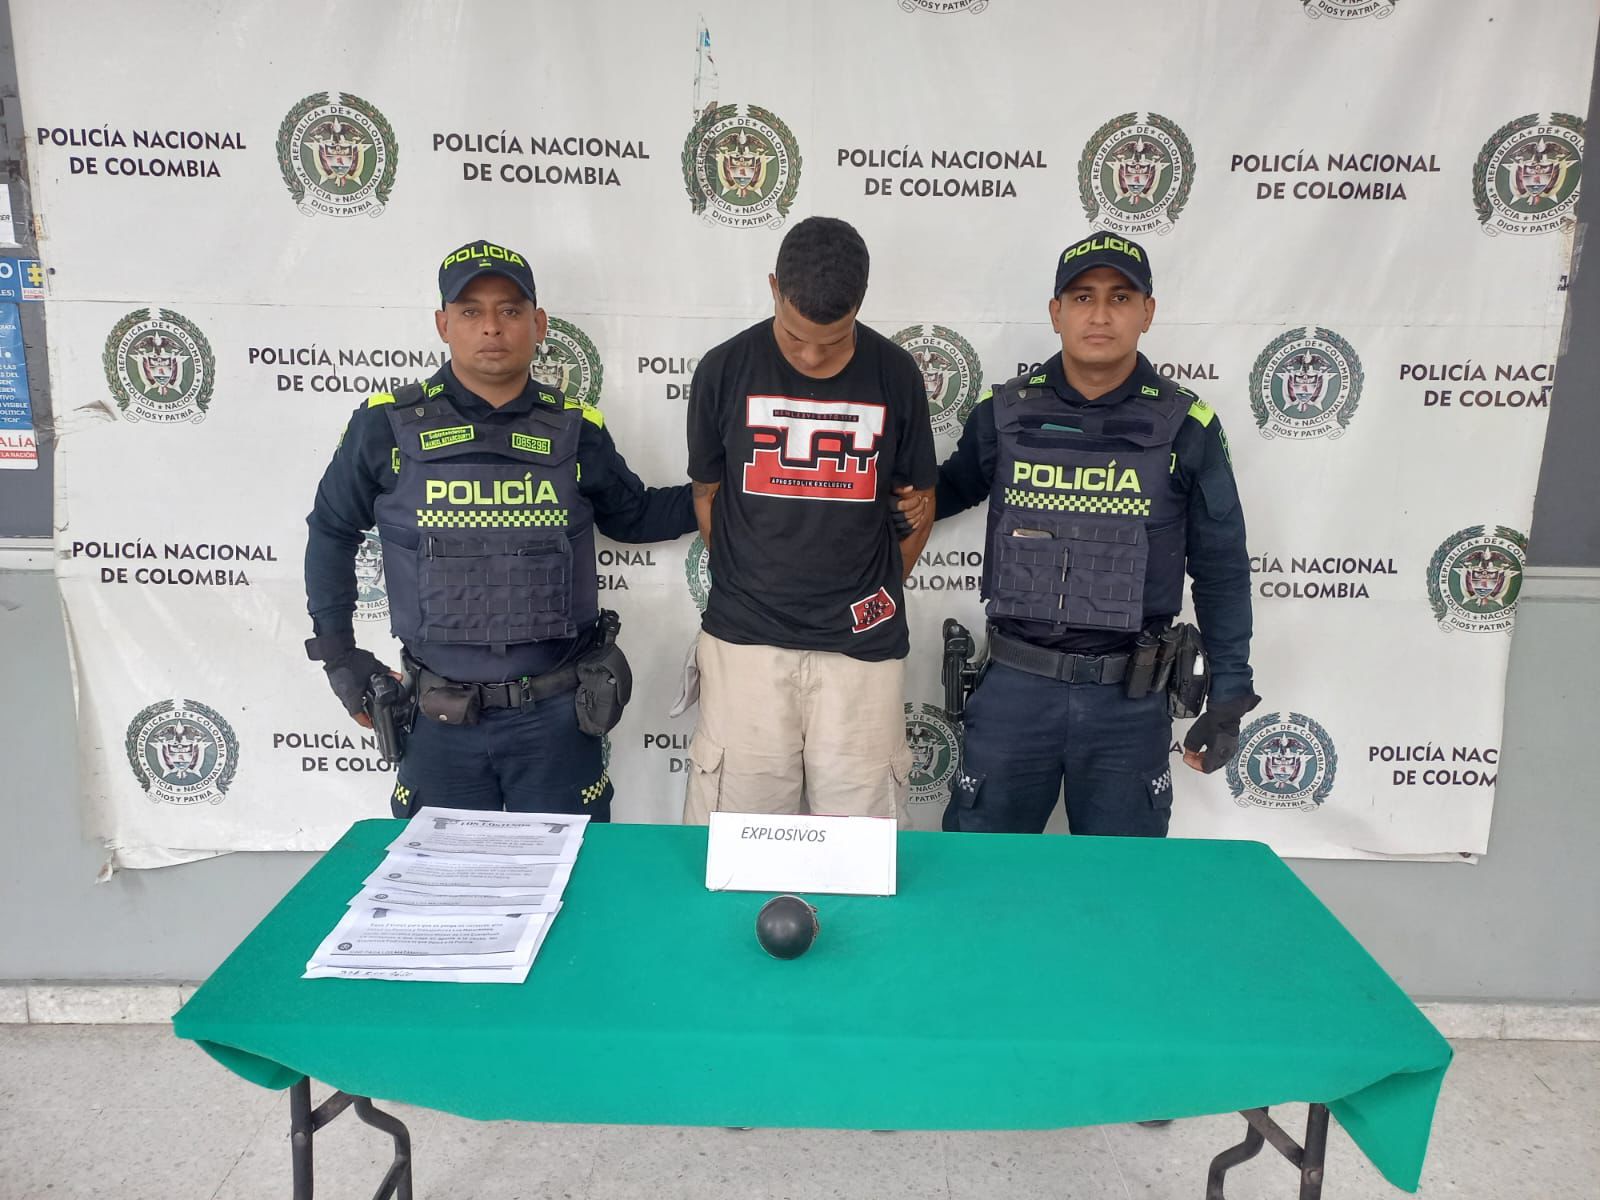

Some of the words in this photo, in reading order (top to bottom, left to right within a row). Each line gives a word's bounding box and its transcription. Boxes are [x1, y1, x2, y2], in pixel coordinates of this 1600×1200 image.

[1347, 2, 1380, 16] PATRIA
[37, 123, 127, 149] POLICÍA
[132, 130, 247, 150] NACIONAL
[354, 114, 384, 163] COLOMBIA
[432, 129, 524, 155] POLICÍA
[530, 136, 650, 160] NACIONAL
[760, 126, 786, 176] COLOMBIA
[837, 144, 924, 169] POLICÍA
[931, 150, 1048, 170] NACIONAL
[1157, 133, 1181, 182] COLOMBIA
[1230, 148, 1321, 173] POLICÍA
[1327, 153, 1441, 173] NACIONAL
[69, 156, 98, 175] DE
[104, 157, 222, 178] COLOMBIA
[463, 162, 493, 182] DE
[499, 163, 622, 187] COLOMBIA
[343, 171, 380, 202] NACIONAL
[864, 177, 893, 196] DE
[899, 178, 1017, 198] COLOMBIA
[1256, 182, 1286, 200] DE
[1292, 181, 1407, 201] COLOMBIA
[343, 200, 372, 214] PATRIA
[742, 187, 782, 214] NACIONAL
[1133, 193, 1175, 220] NACIONAL
[742, 213, 773, 225] PATRIA
[1131, 219, 1162, 232] PATRIA
[172, 327, 201, 374] COLOMBIA
[248, 343, 333, 367] POLICÍA
[561, 336, 589, 382] COLOMBIA
[944, 343, 968, 389] COLOMBIA
[1325, 345, 1348, 390] COLOMBIA
[1399, 359, 1487, 381] POLICÍA
[277, 374, 304, 392] DE
[165, 383, 200, 409] NACIONAL
[1423, 390, 1453, 407] DE
[165, 408, 194, 421] PATRIA
[1302, 400, 1344, 426] NACIONAL
[1301, 425, 1333, 437] PATRIA
[1013, 459, 1142, 493] POLICÍA
[426, 472, 559, 505] POLICÍA
[72, 537, 158, 560] POLICÍA
[164, 543, 278, 562] NACIONAL
[100, 567, 129, 584] DE
[134, 567, 250, 586] COLOMBIA
[1291, 557, 1398, 575] NACIONAL
[1259, 581, 1370, 599] COLOMBIA
[1479, 621, 1512, 630] PATRIA
[196, 716, 225, 758] COLOMBIA
[273, 729, 356, 750] POLICÍA
[933, 720, 957, 761] COLOMBIA
[1300, 729, 1324, 772] COLOMBIA
[1369, 741, 1445, 762] POLICÍA
[302, 756, 329, 772] DE
[184, 767, 221, 792] NACIONAL
[916, 770, 953, 792] NACIONAL
[1392, 769, 1417, 786] DE
[184, 790, 213, 802] PATRIA
[915, 791, 943, 802] PATRIA
[1277, 780, 1320, 800] NACIONAL
[741, 826, 827, 843] EXPLOSIVOS
